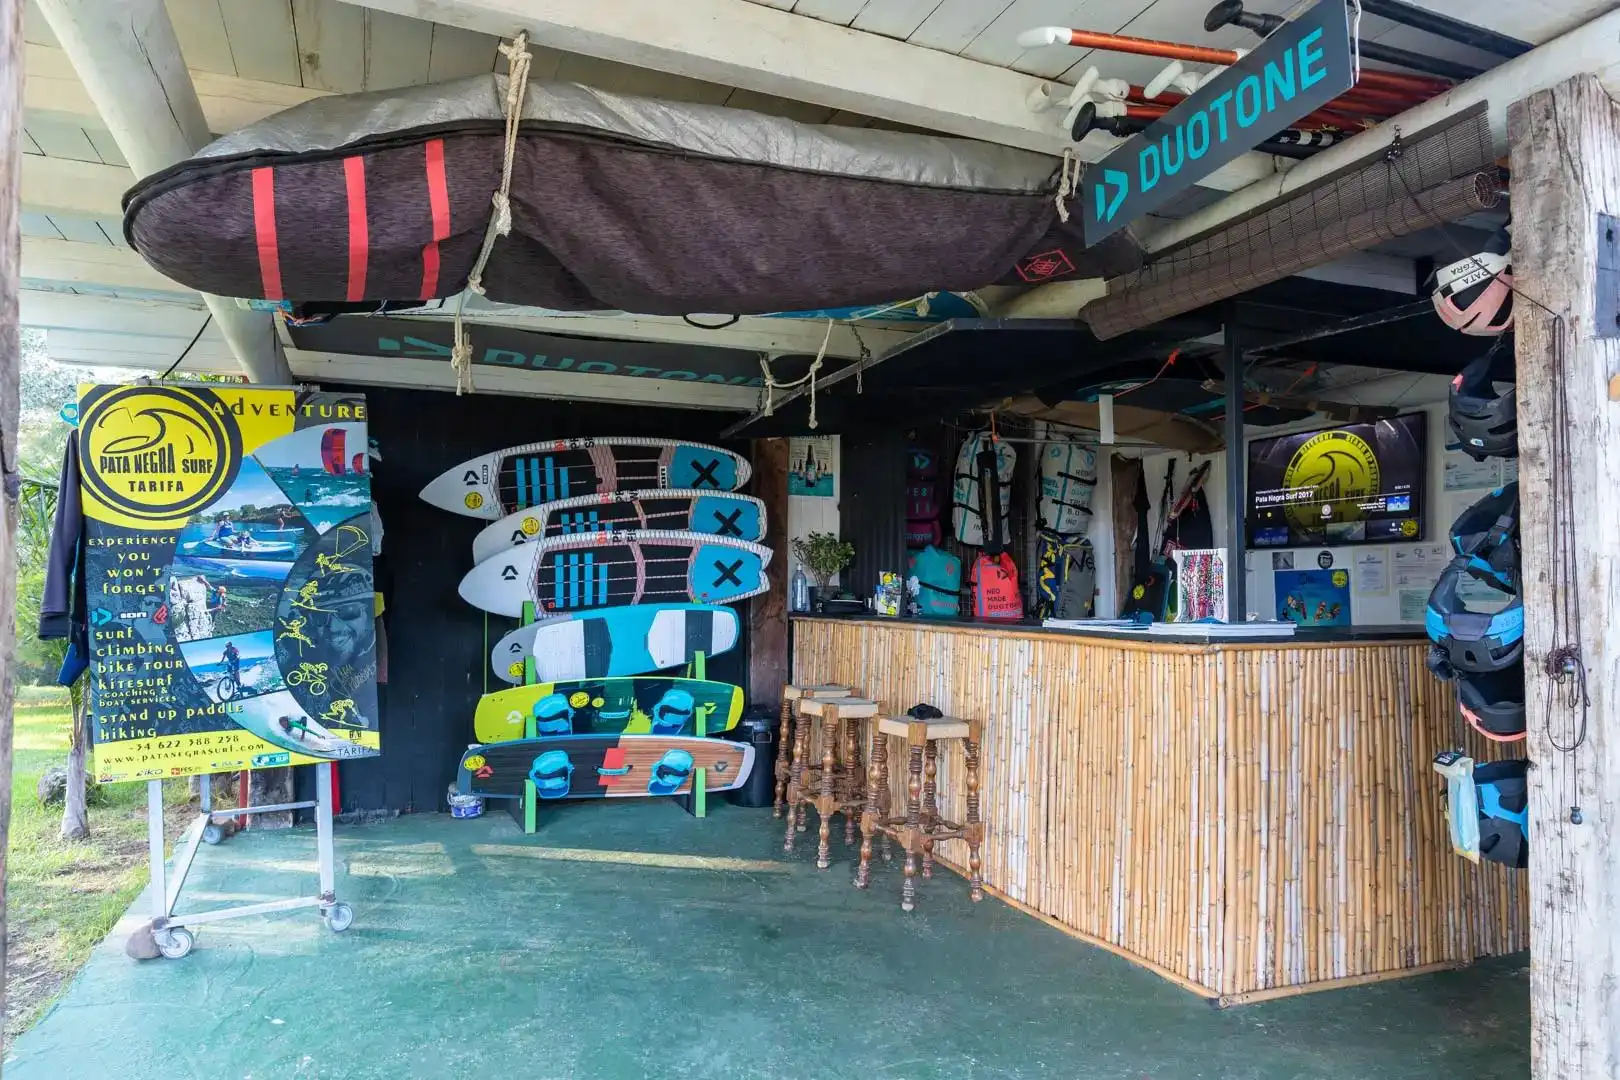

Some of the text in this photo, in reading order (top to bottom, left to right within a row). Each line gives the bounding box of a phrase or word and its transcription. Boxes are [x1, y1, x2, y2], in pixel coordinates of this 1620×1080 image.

[1139, 26, 1327, 193] DUOTONE
[100, 443, 213, 474] PATA NEGRA SURF
[128, 481, 184, 492] TARIFA
[1255, 490, 1313, 503] Pata Negra Surf 2017
[158, 740, 181, 750] 622
